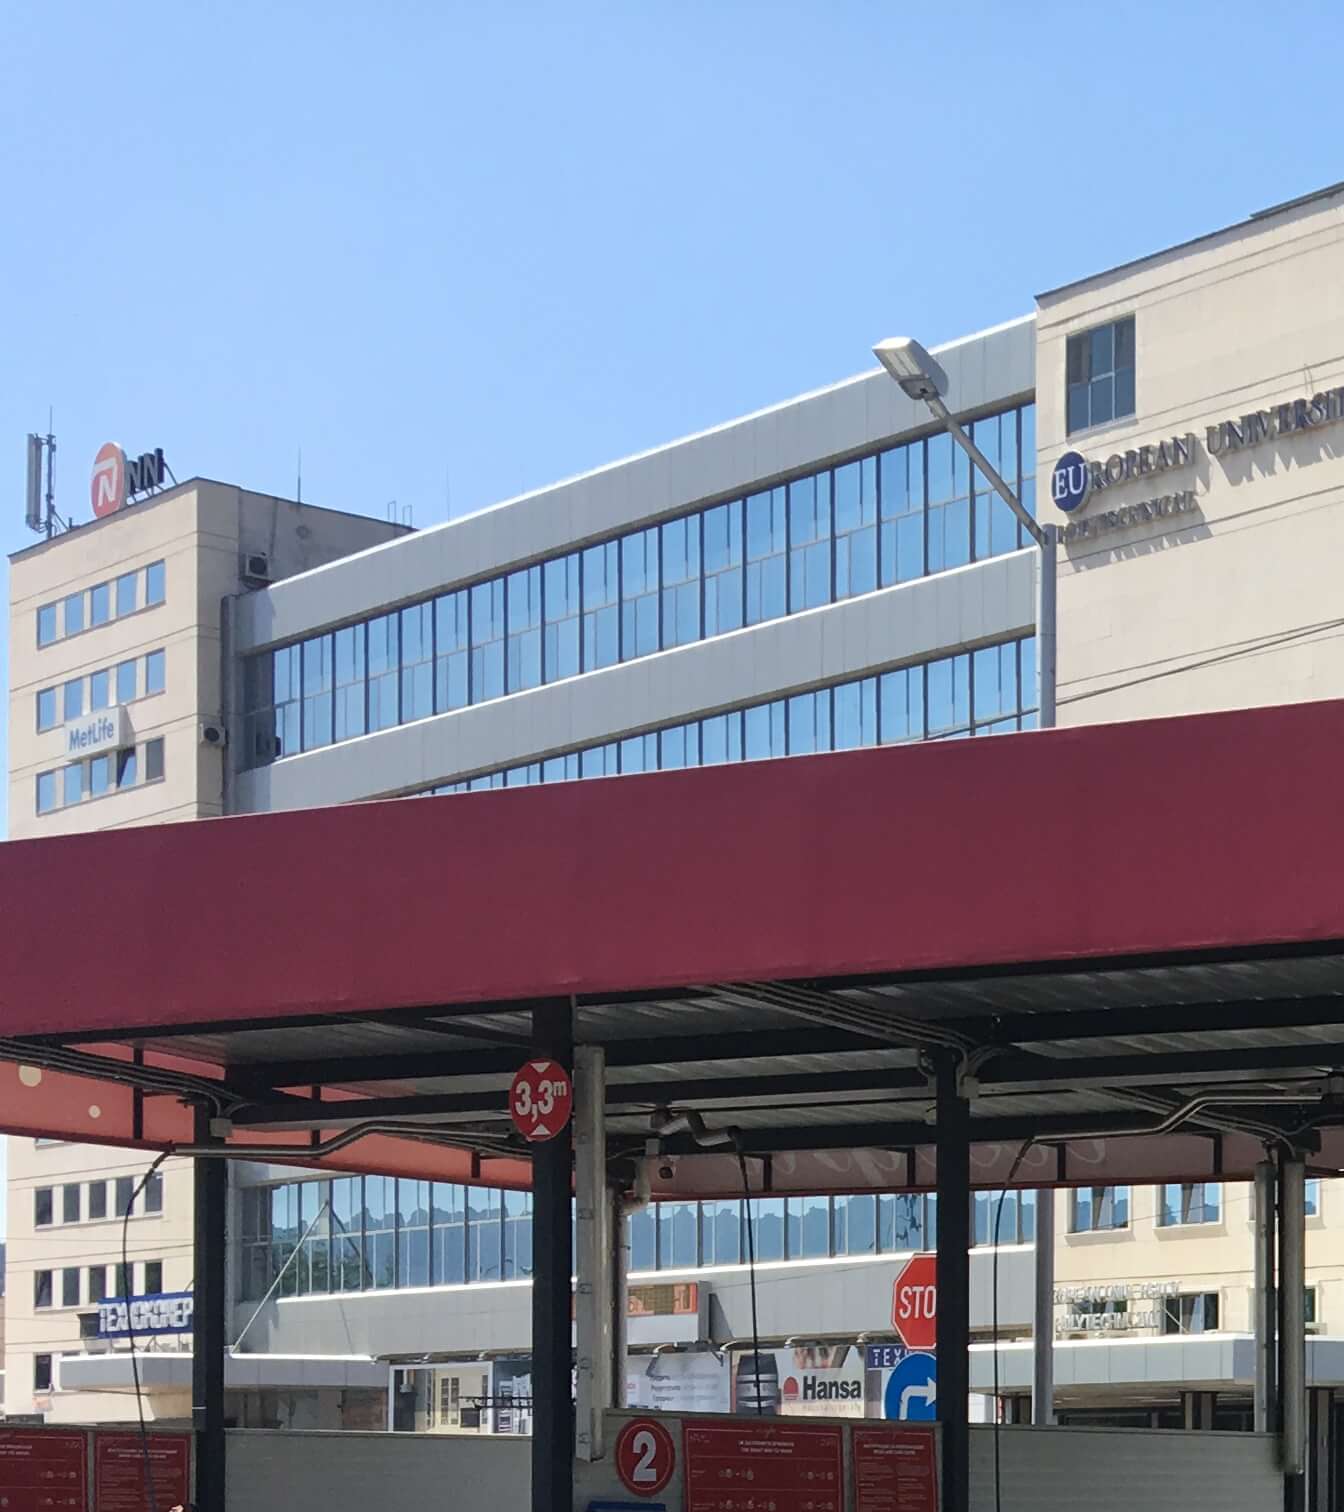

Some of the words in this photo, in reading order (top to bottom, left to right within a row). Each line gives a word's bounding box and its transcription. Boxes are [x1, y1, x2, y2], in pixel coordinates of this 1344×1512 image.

[68, 717, 114, 752] MetLife
[899, 1285, 938, 1319] STO
[802, 1375, 862, 1401] Hansa
[632, 1430, 657, 1482] 2
